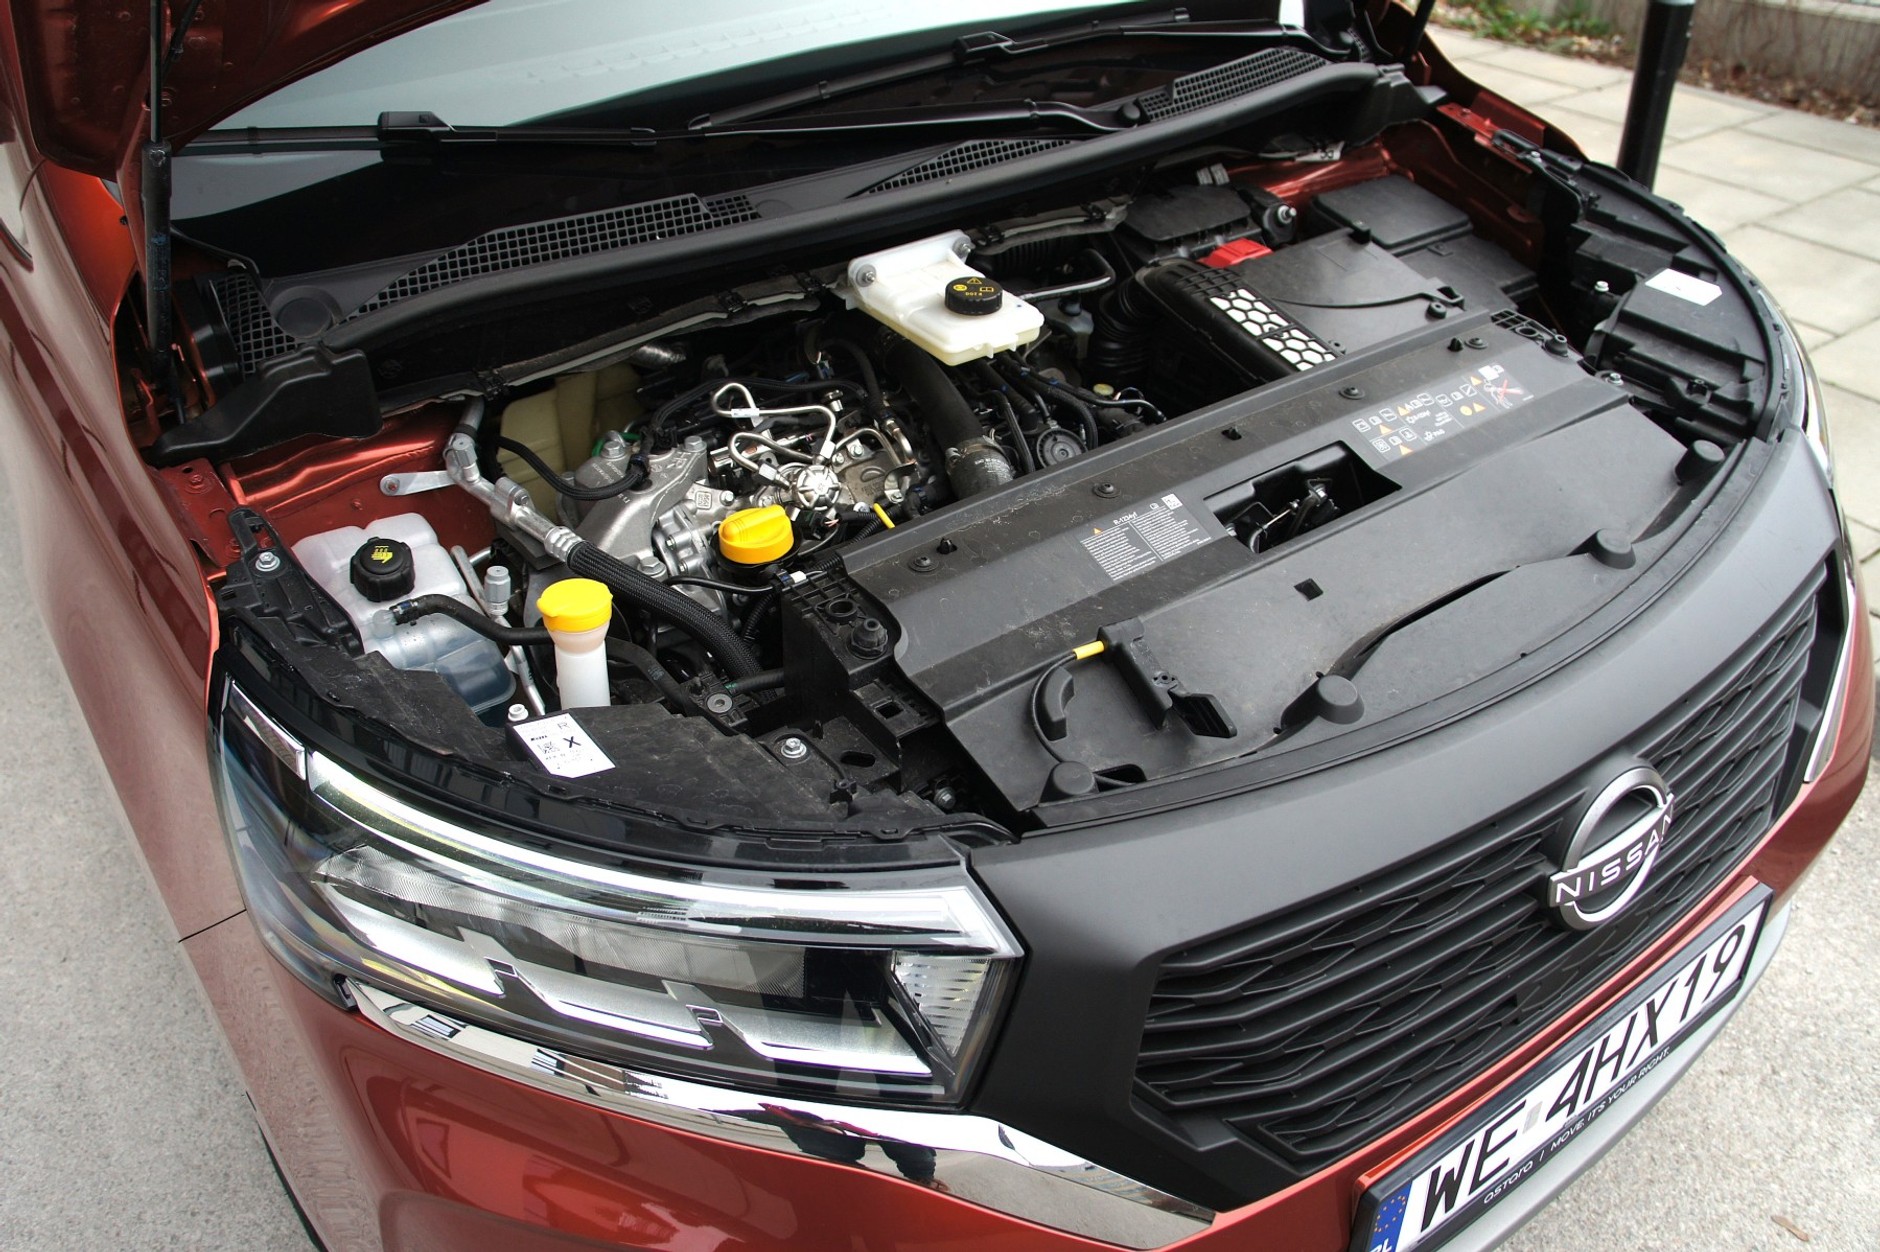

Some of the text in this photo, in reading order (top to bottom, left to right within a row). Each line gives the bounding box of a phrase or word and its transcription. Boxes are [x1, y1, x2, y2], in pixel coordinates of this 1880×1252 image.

[1556, 803, 1675, 903] NISSAN
[1420, 924, 1746, 1234] WE 4HX19
[1608, 1075, 1637, 1103] YOUR
